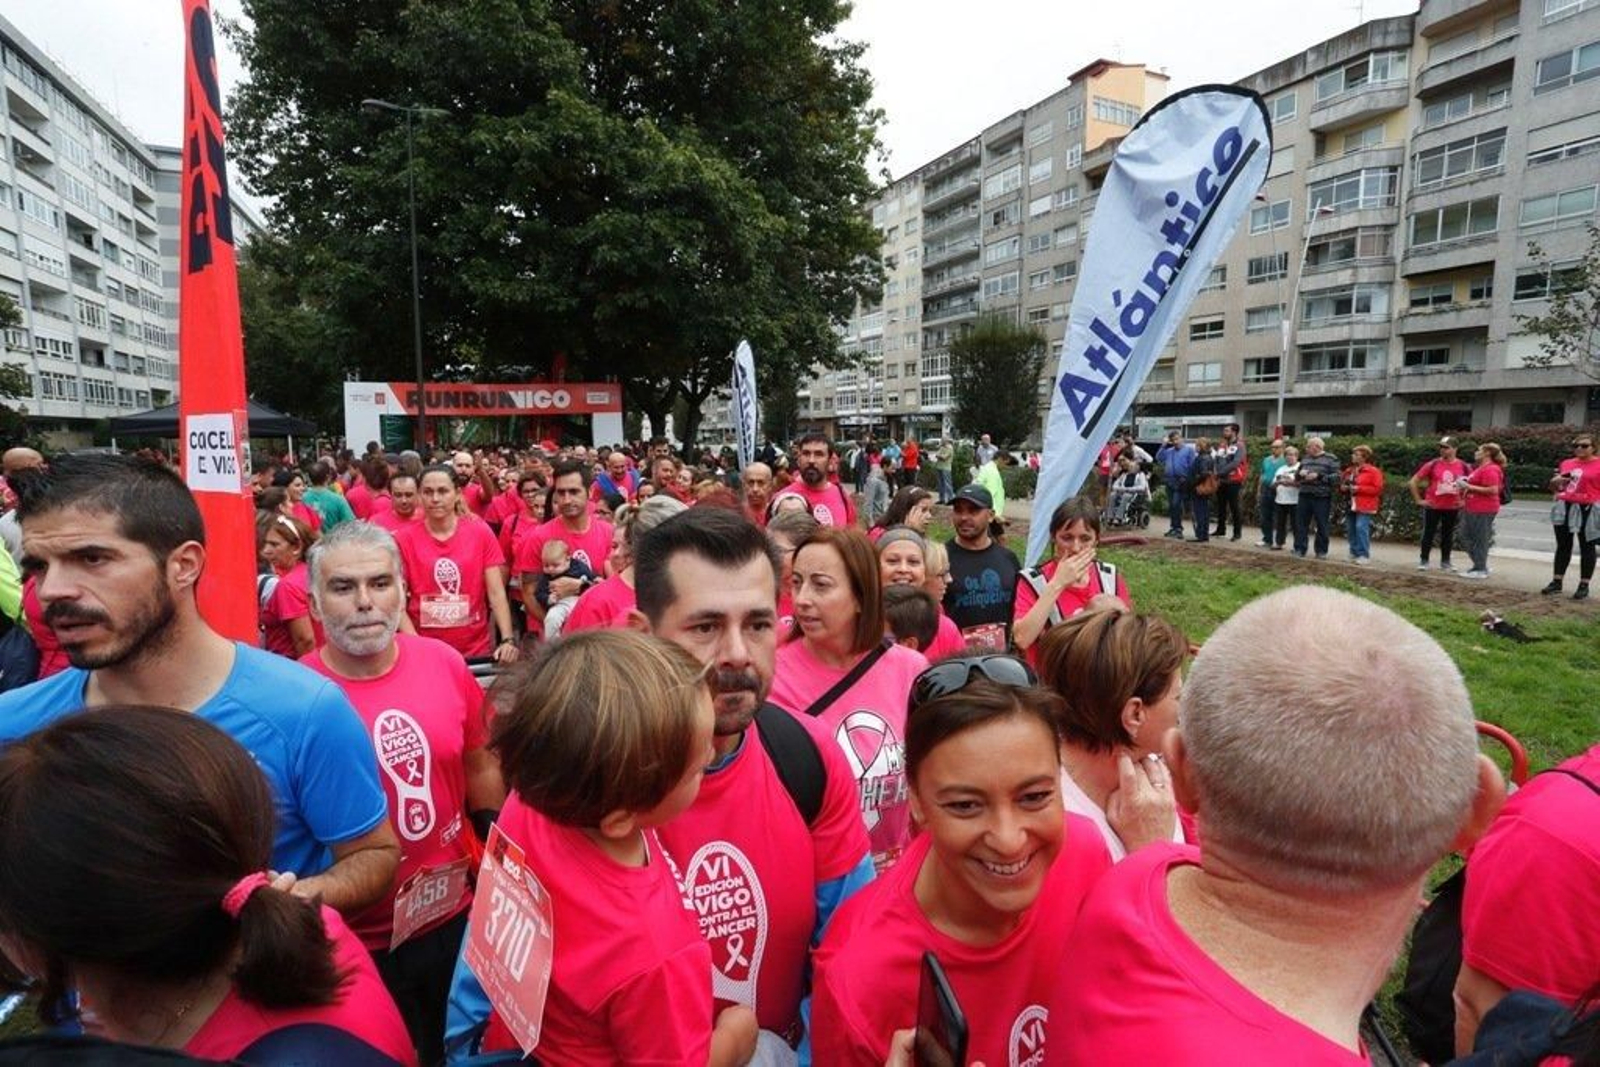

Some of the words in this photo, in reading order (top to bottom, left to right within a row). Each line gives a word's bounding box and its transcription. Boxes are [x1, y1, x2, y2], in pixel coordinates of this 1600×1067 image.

[1058, 125, 1243, 431] Atlántico
[382, 716, 403, 732] VI
[382, 733, 418, 751] VIGO
[702, 855, 731, 882] VI
[405, 875, 449, 919] 4458
[694, 887, 752, 916] VIGO
[698, 908, 740, 928] ONTRA
[741, 904, 757, 917] EL
[484, 886, 536, 983] 3710
[1020, 1019, 1046, 1053] VI
